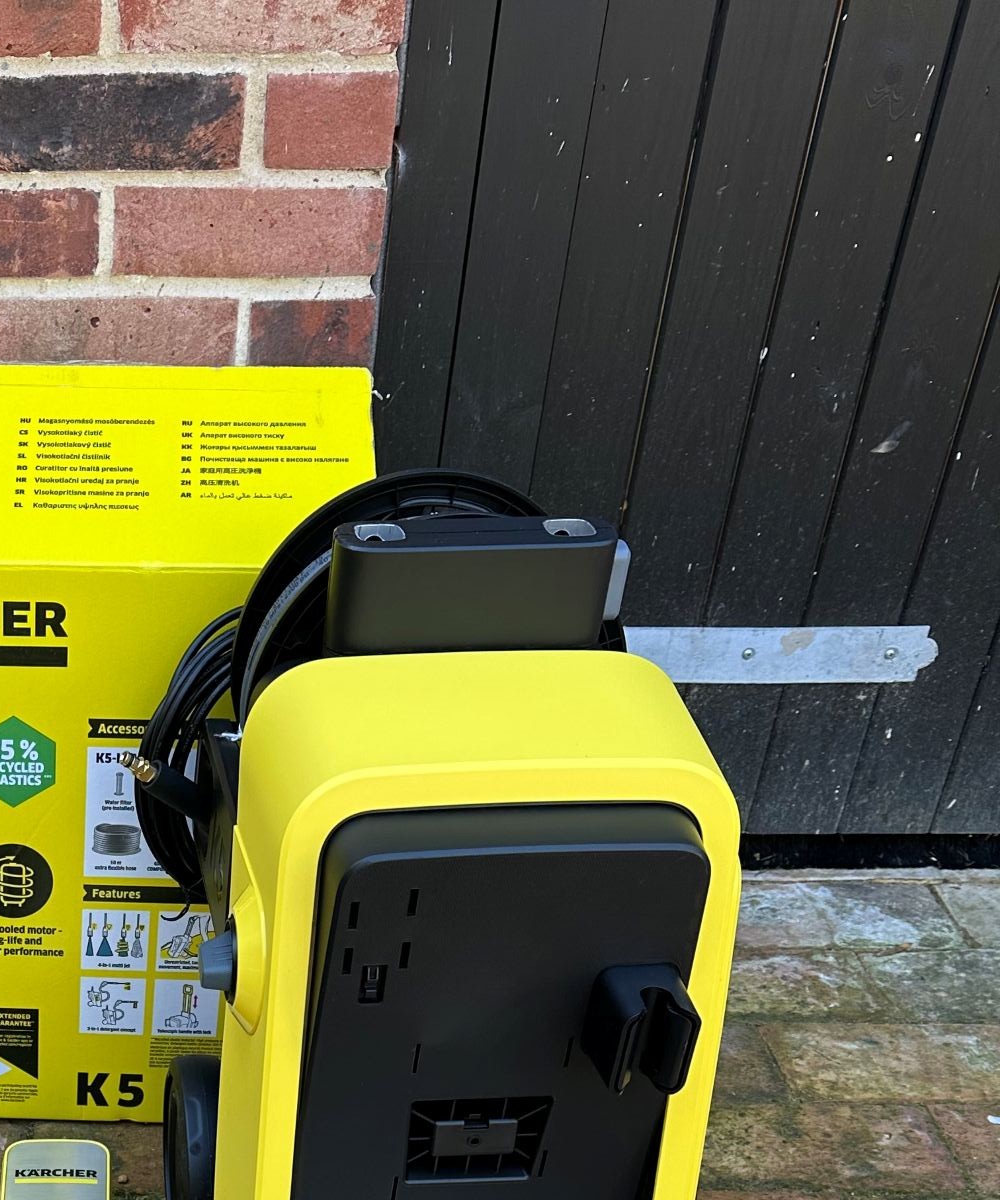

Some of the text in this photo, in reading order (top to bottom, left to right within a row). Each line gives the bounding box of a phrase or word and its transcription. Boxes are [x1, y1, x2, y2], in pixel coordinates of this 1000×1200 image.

[98, 723, 147, 735] Accesso
[20, 739, 38, 760] %
[92, 888, 141, 900] Features
[27, 926, 57, 935] motor
[24, 937, 42, 945] and
[4, 947, 64, 957] performance
[77, 1072, 110, 1106] K
[120, 1074, 144, 1107] 5
[15, 1169, 97, 1177] KÄRCHER
